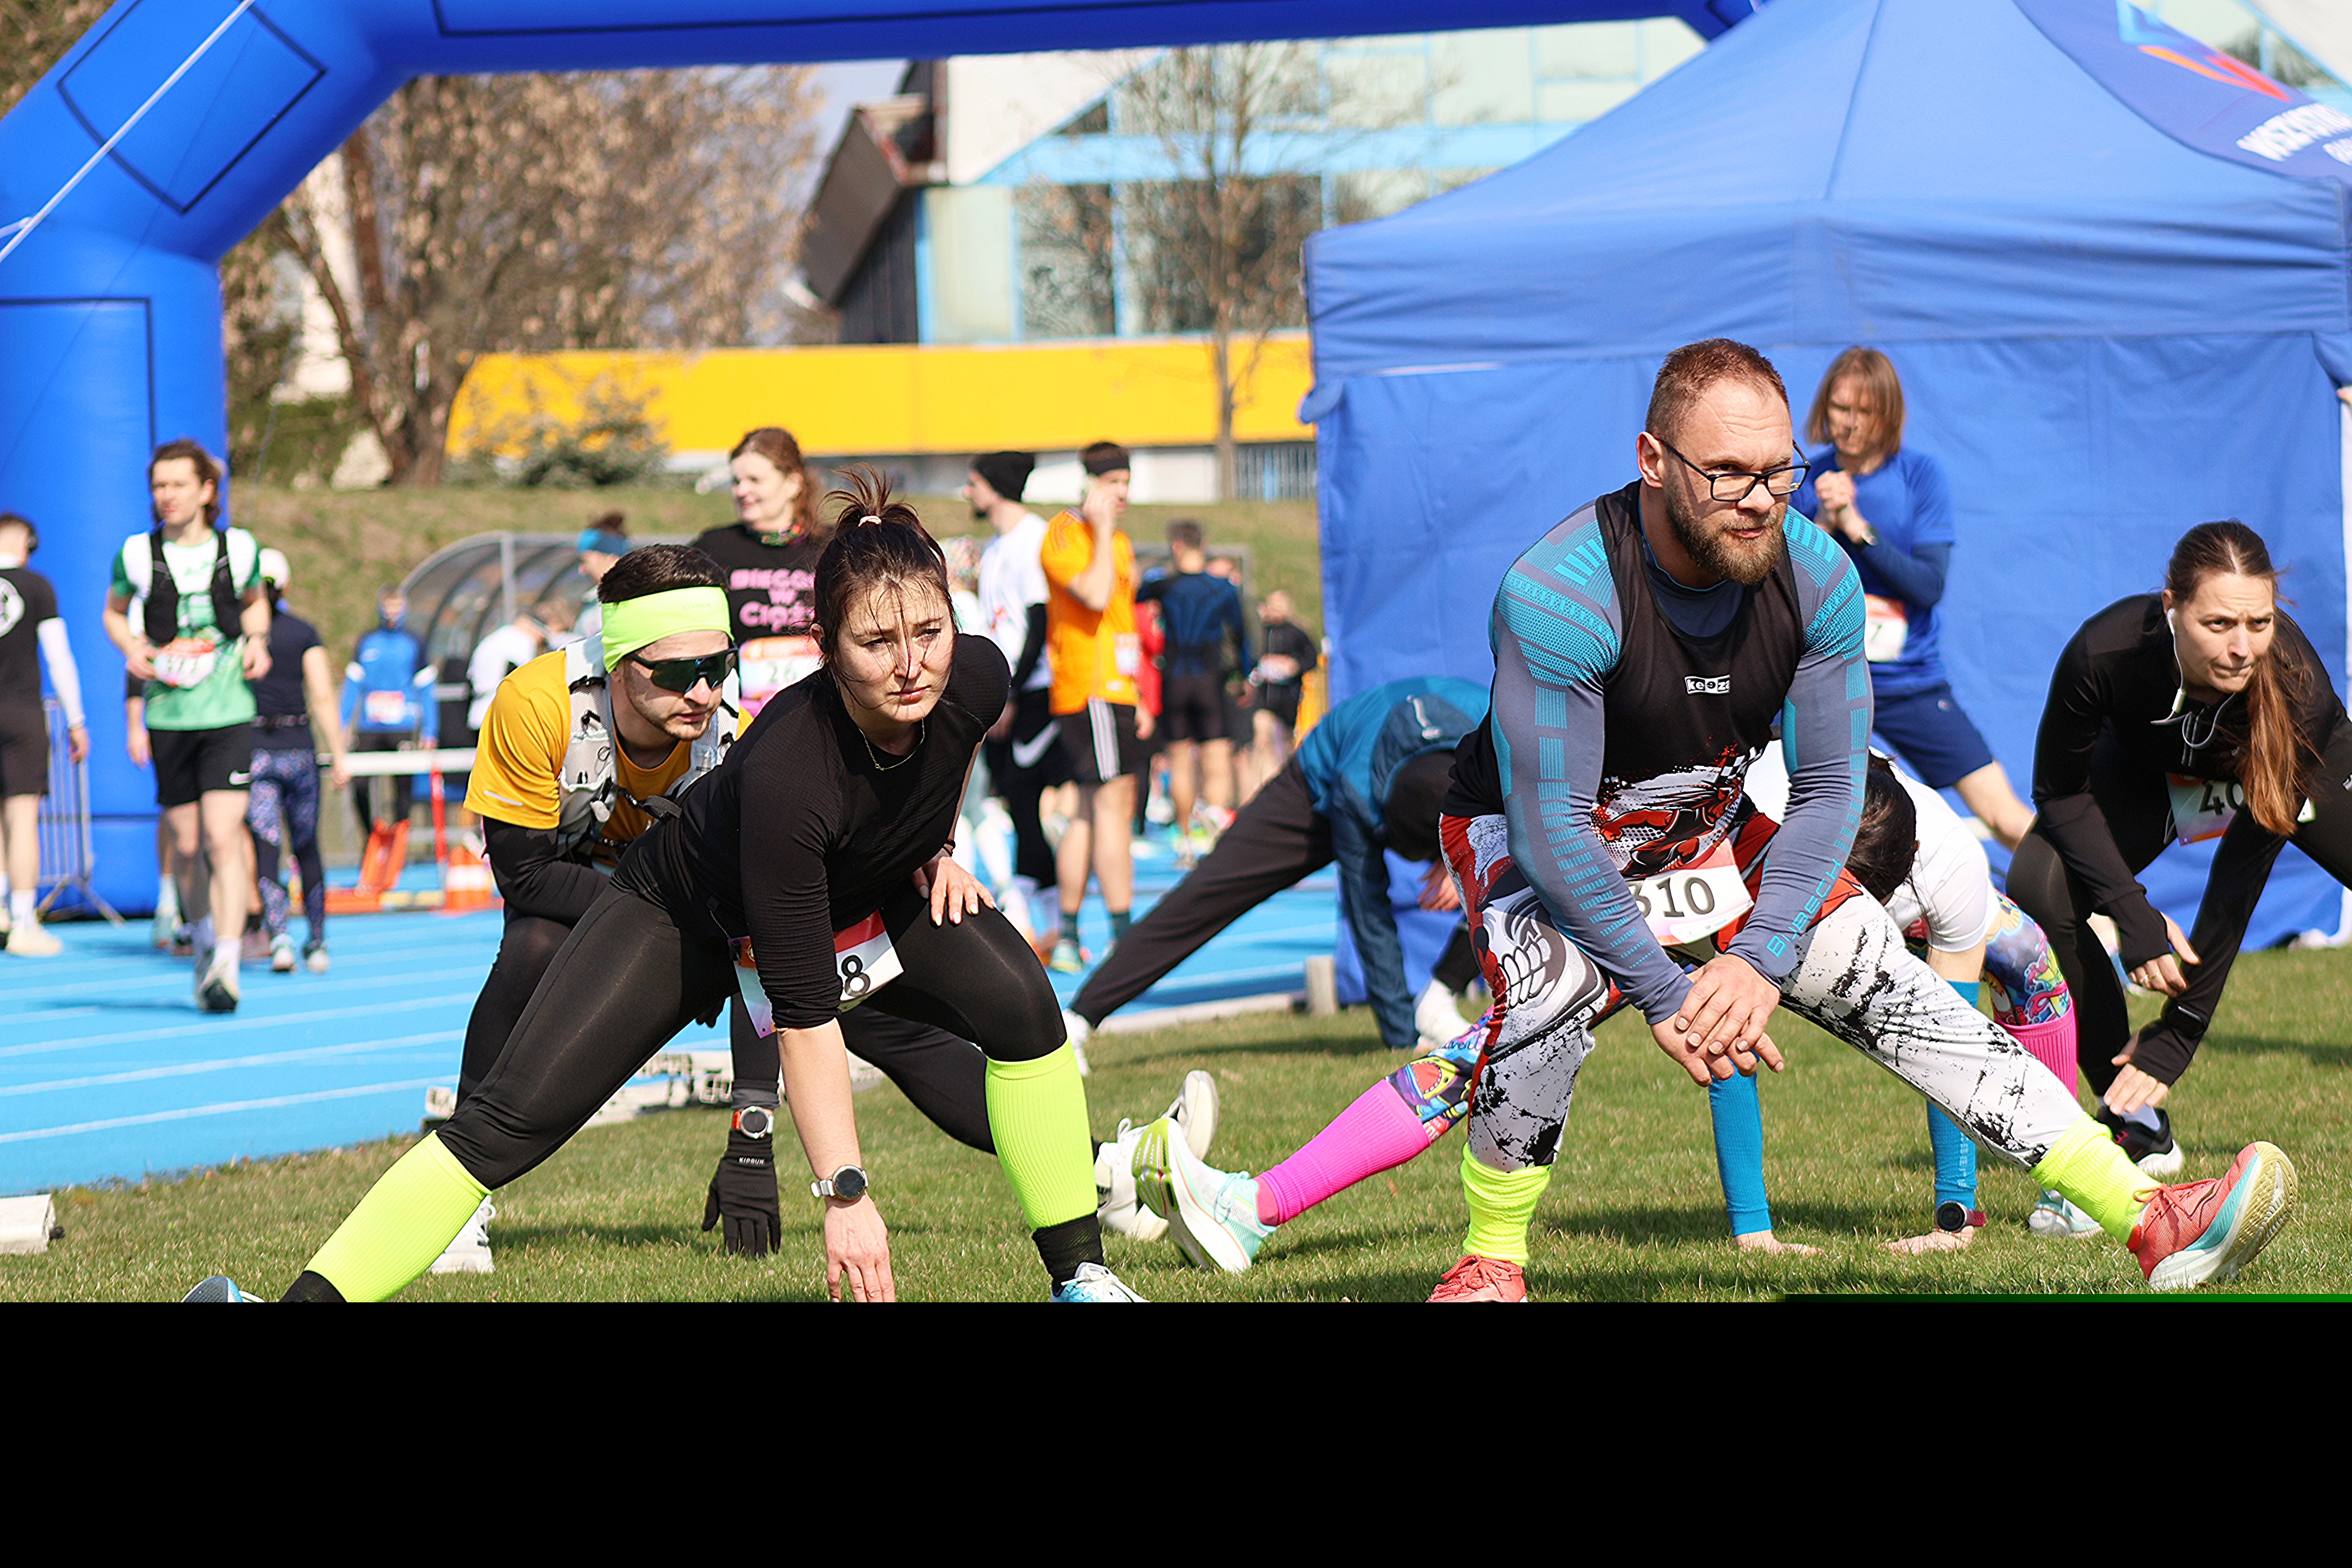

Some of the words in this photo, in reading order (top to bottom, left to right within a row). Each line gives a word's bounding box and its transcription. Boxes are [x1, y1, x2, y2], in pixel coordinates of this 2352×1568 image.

[1626, 876, 1715, 919] 310
[841, 954, 871, 997] 8
[739, 1157, 764, 1165] KIPRUN
